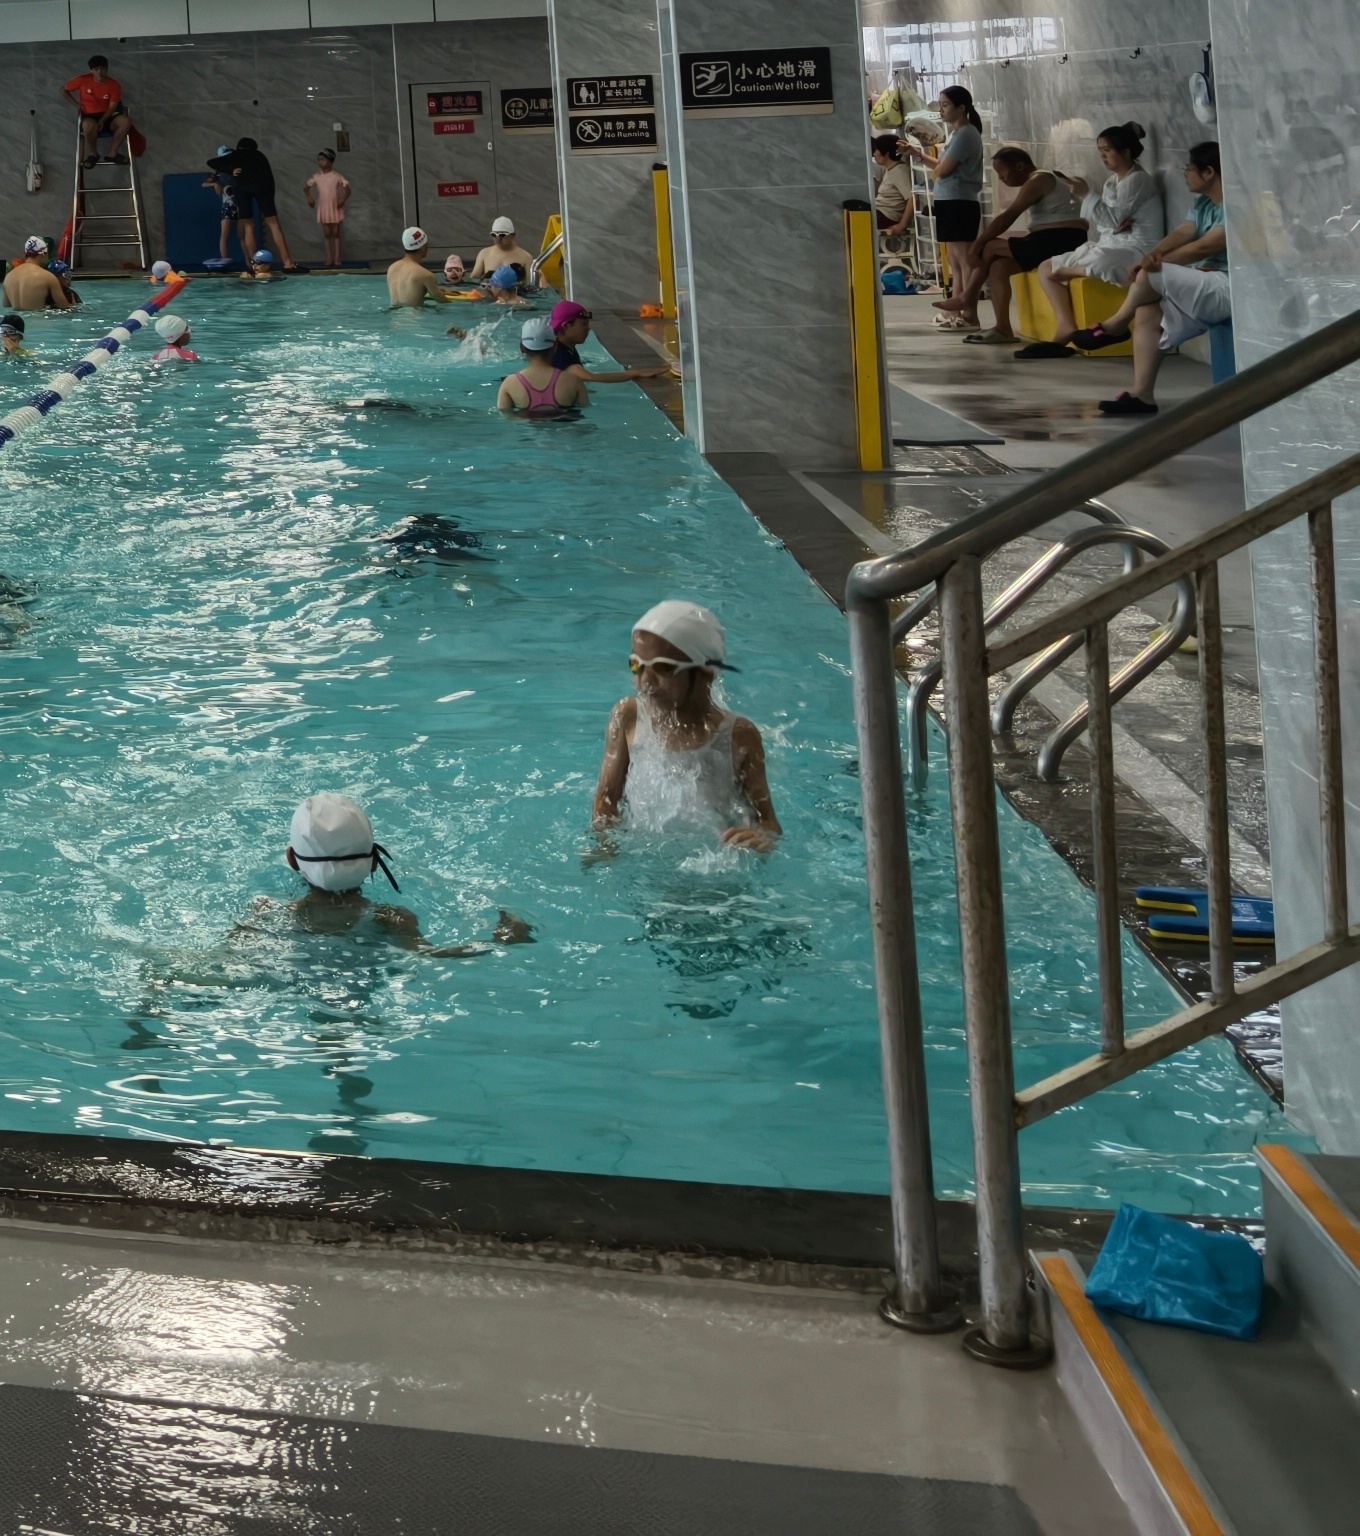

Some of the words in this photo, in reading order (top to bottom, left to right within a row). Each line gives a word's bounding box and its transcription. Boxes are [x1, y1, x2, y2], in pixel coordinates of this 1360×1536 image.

[735, 60, 816, 80] 小心地滑
[796, 80, 820, 91] floor
[603, 120, 649, 130] 请勿奔跑
[617, 130, 650, 138] Running
